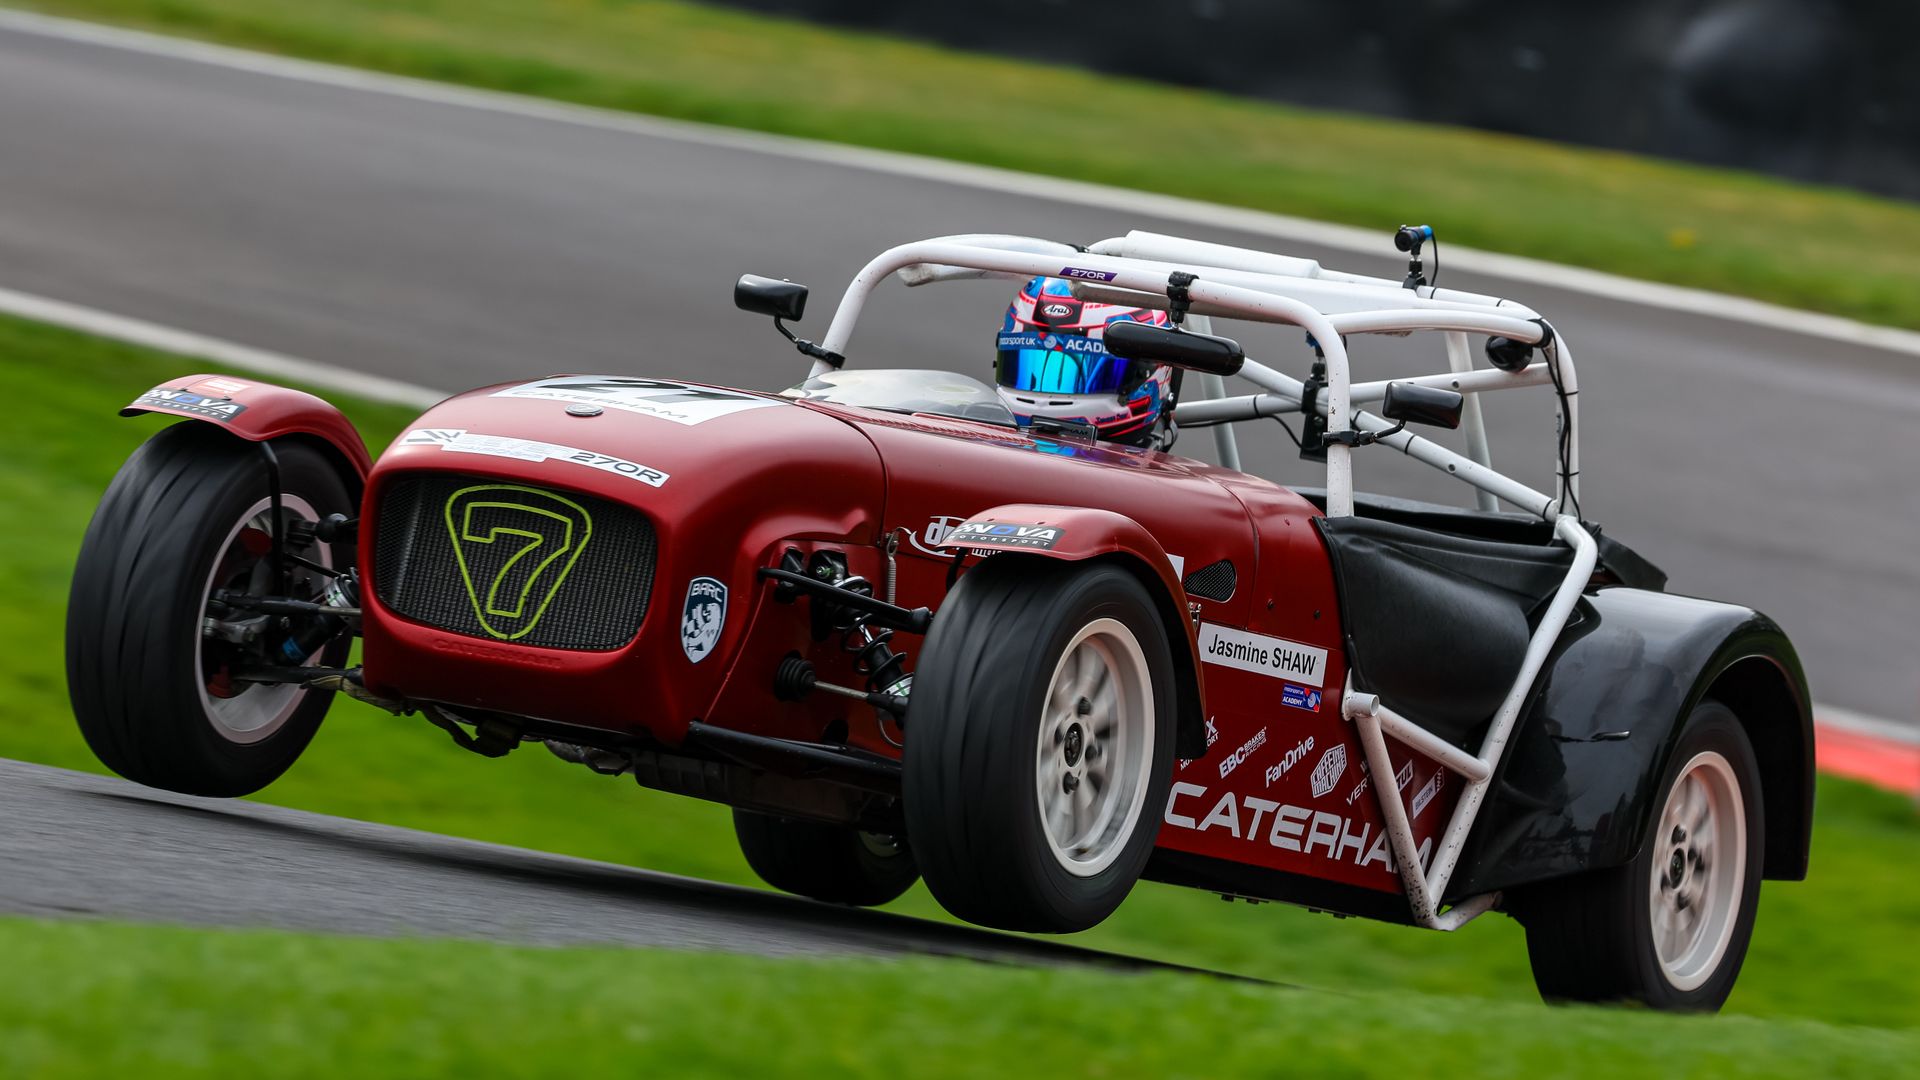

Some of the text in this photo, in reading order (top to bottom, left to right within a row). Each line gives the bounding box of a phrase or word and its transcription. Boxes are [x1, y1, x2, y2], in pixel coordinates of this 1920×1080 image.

[1070, 269, 1106, 280] 270R
[1046, 304, 1068, 315] Arai
[1026, 337, 1036, 345] UK
[511, 391, 689, 419] CATERHAM
[569, 451, 663, 483] 270R
[462, 502, 573, 618] 7
[691, 582, 723, 602] BARC
[1208, 634, 1317, 676] Jasmine SHAW
[1282, 696, 1303, 706] ACADEMY
[1219, 746, 1246, 779] EBC
[1265, 735, 1315, 789] FanDrive
[1312, 746, 1345, 785] CAFFEINE
[1313, 757, 1346, 795] MACHINE
